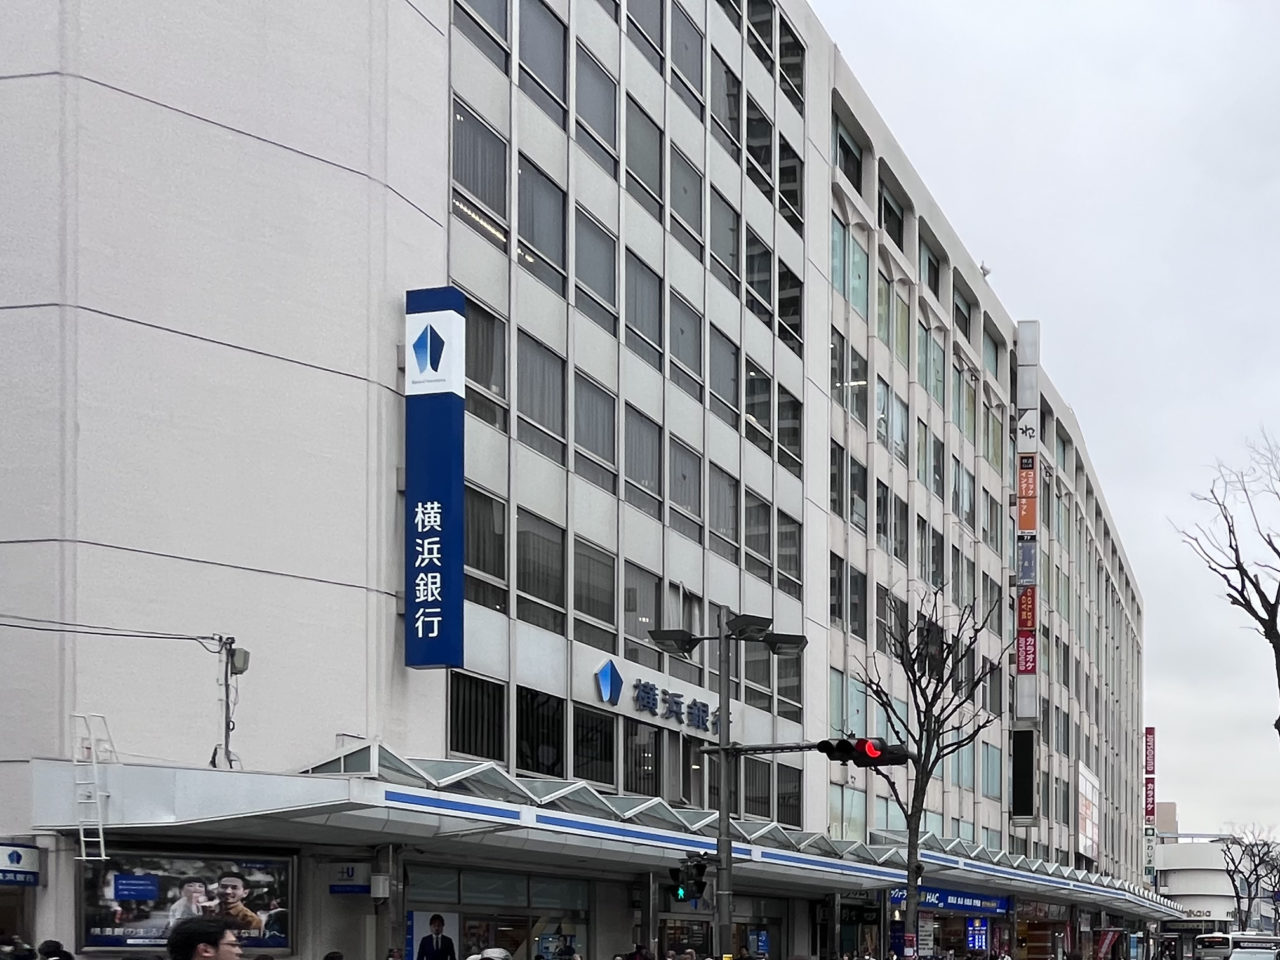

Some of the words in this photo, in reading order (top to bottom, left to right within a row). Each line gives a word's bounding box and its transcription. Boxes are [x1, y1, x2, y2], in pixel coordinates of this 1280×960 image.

[415, 501, 442, 638] 横浜銀行
[1026, 637, 1034, 669] カラオケ
